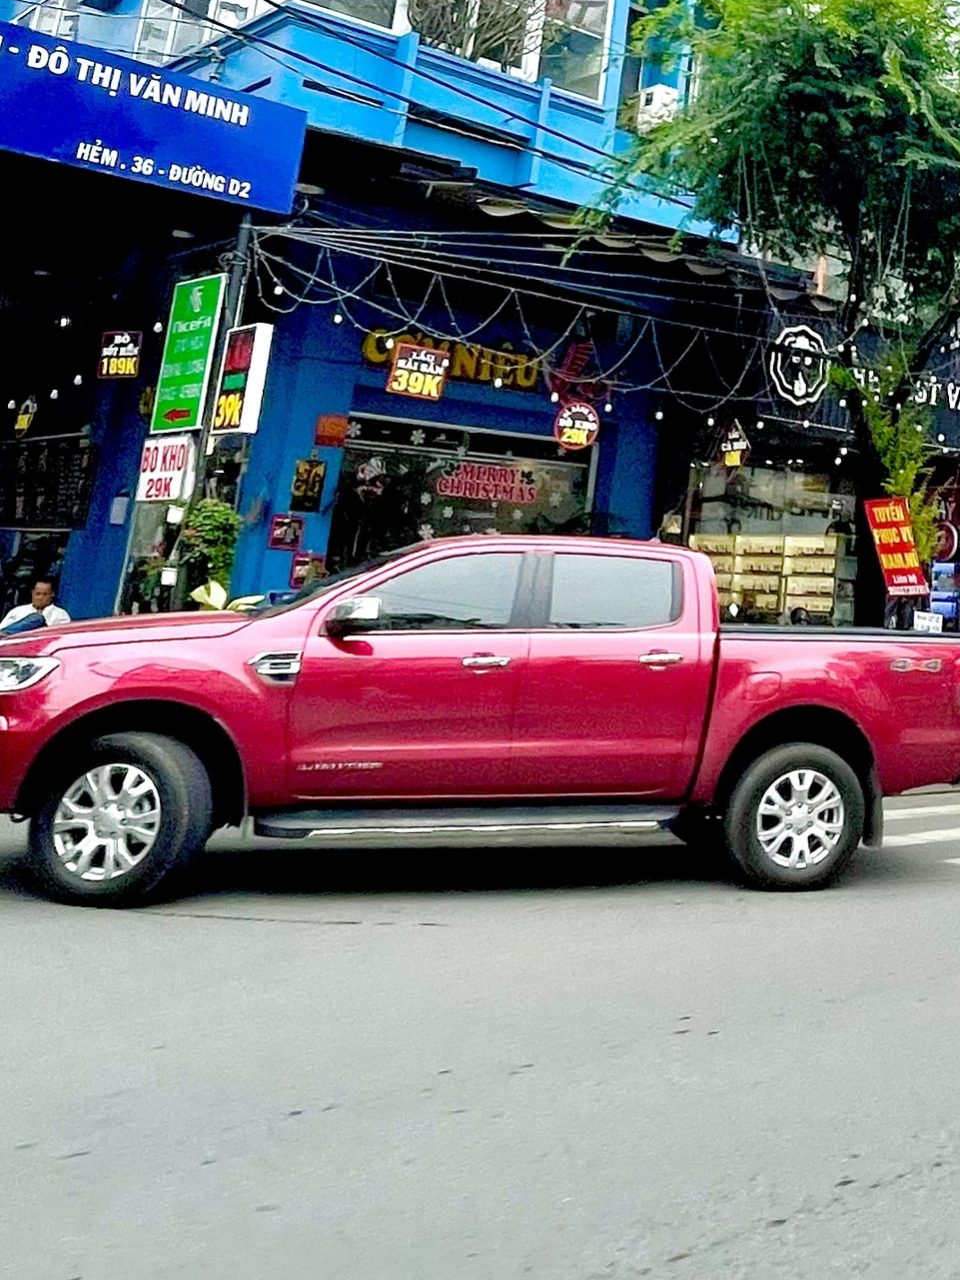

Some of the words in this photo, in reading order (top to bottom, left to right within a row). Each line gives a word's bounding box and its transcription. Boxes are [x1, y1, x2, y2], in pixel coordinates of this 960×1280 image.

[27, 44, 70, 75] ĐÔ
[76, 57, 122, 97] THỊ
[128, 73, 182, 108] VĂN
[183, 89, 250, 127] MINH
[76, 139, 118, 169] HẺM
[131, 156, 154, 176] 36
[168, 163, 225, 193] ĐƯỜNG
[228, 177, 251, 199] D2
[391, 369, 443, 398] 39K
[160, 444, 188, 471] KHO
[460, 462, 520, 484] MERRY
[145, 476, 173, 499] 29K
[437, 478, 538, 503] CHRISTMAS
